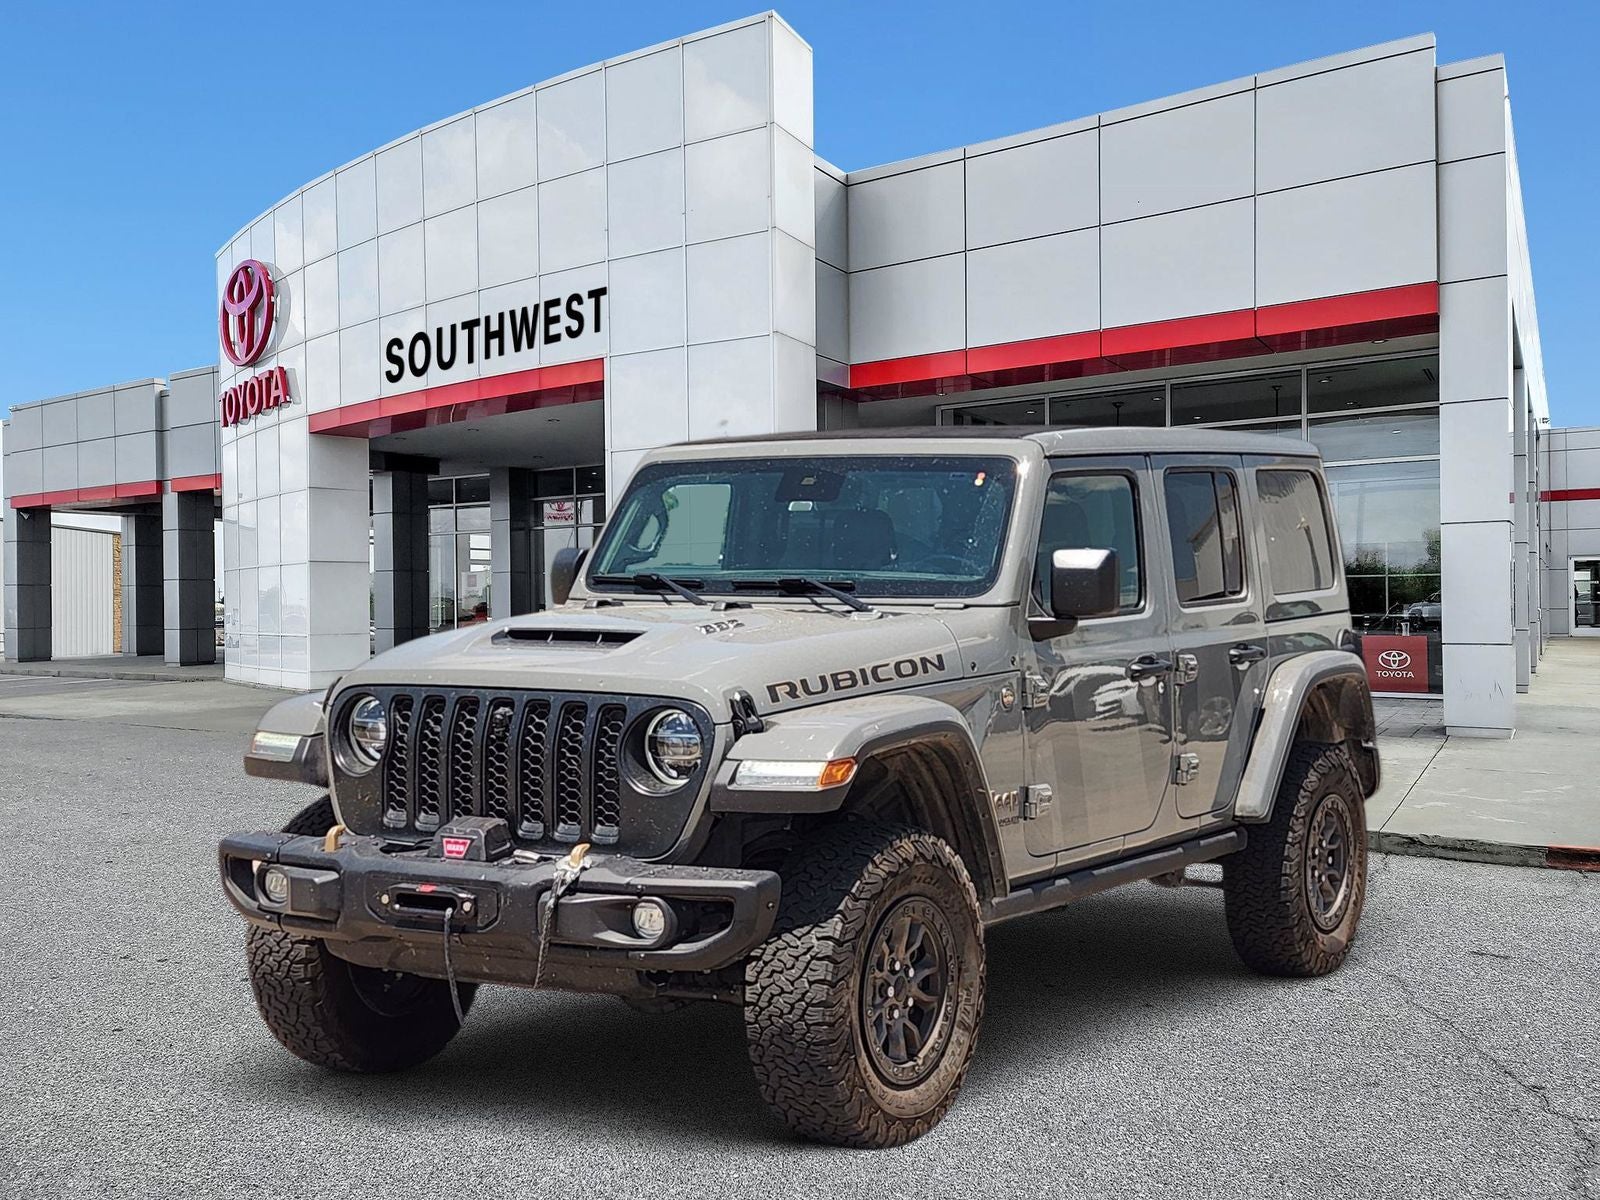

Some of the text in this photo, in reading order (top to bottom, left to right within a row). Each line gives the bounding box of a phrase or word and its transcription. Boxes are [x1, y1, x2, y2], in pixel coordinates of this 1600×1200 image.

[385, 286, 608, 384] SOUTHWEST
[219, 366, 291, 427] TOYOTA
[766, 653, 946, 703] RUBICON
[1375, 670, 1415, 679] TOYOTA
